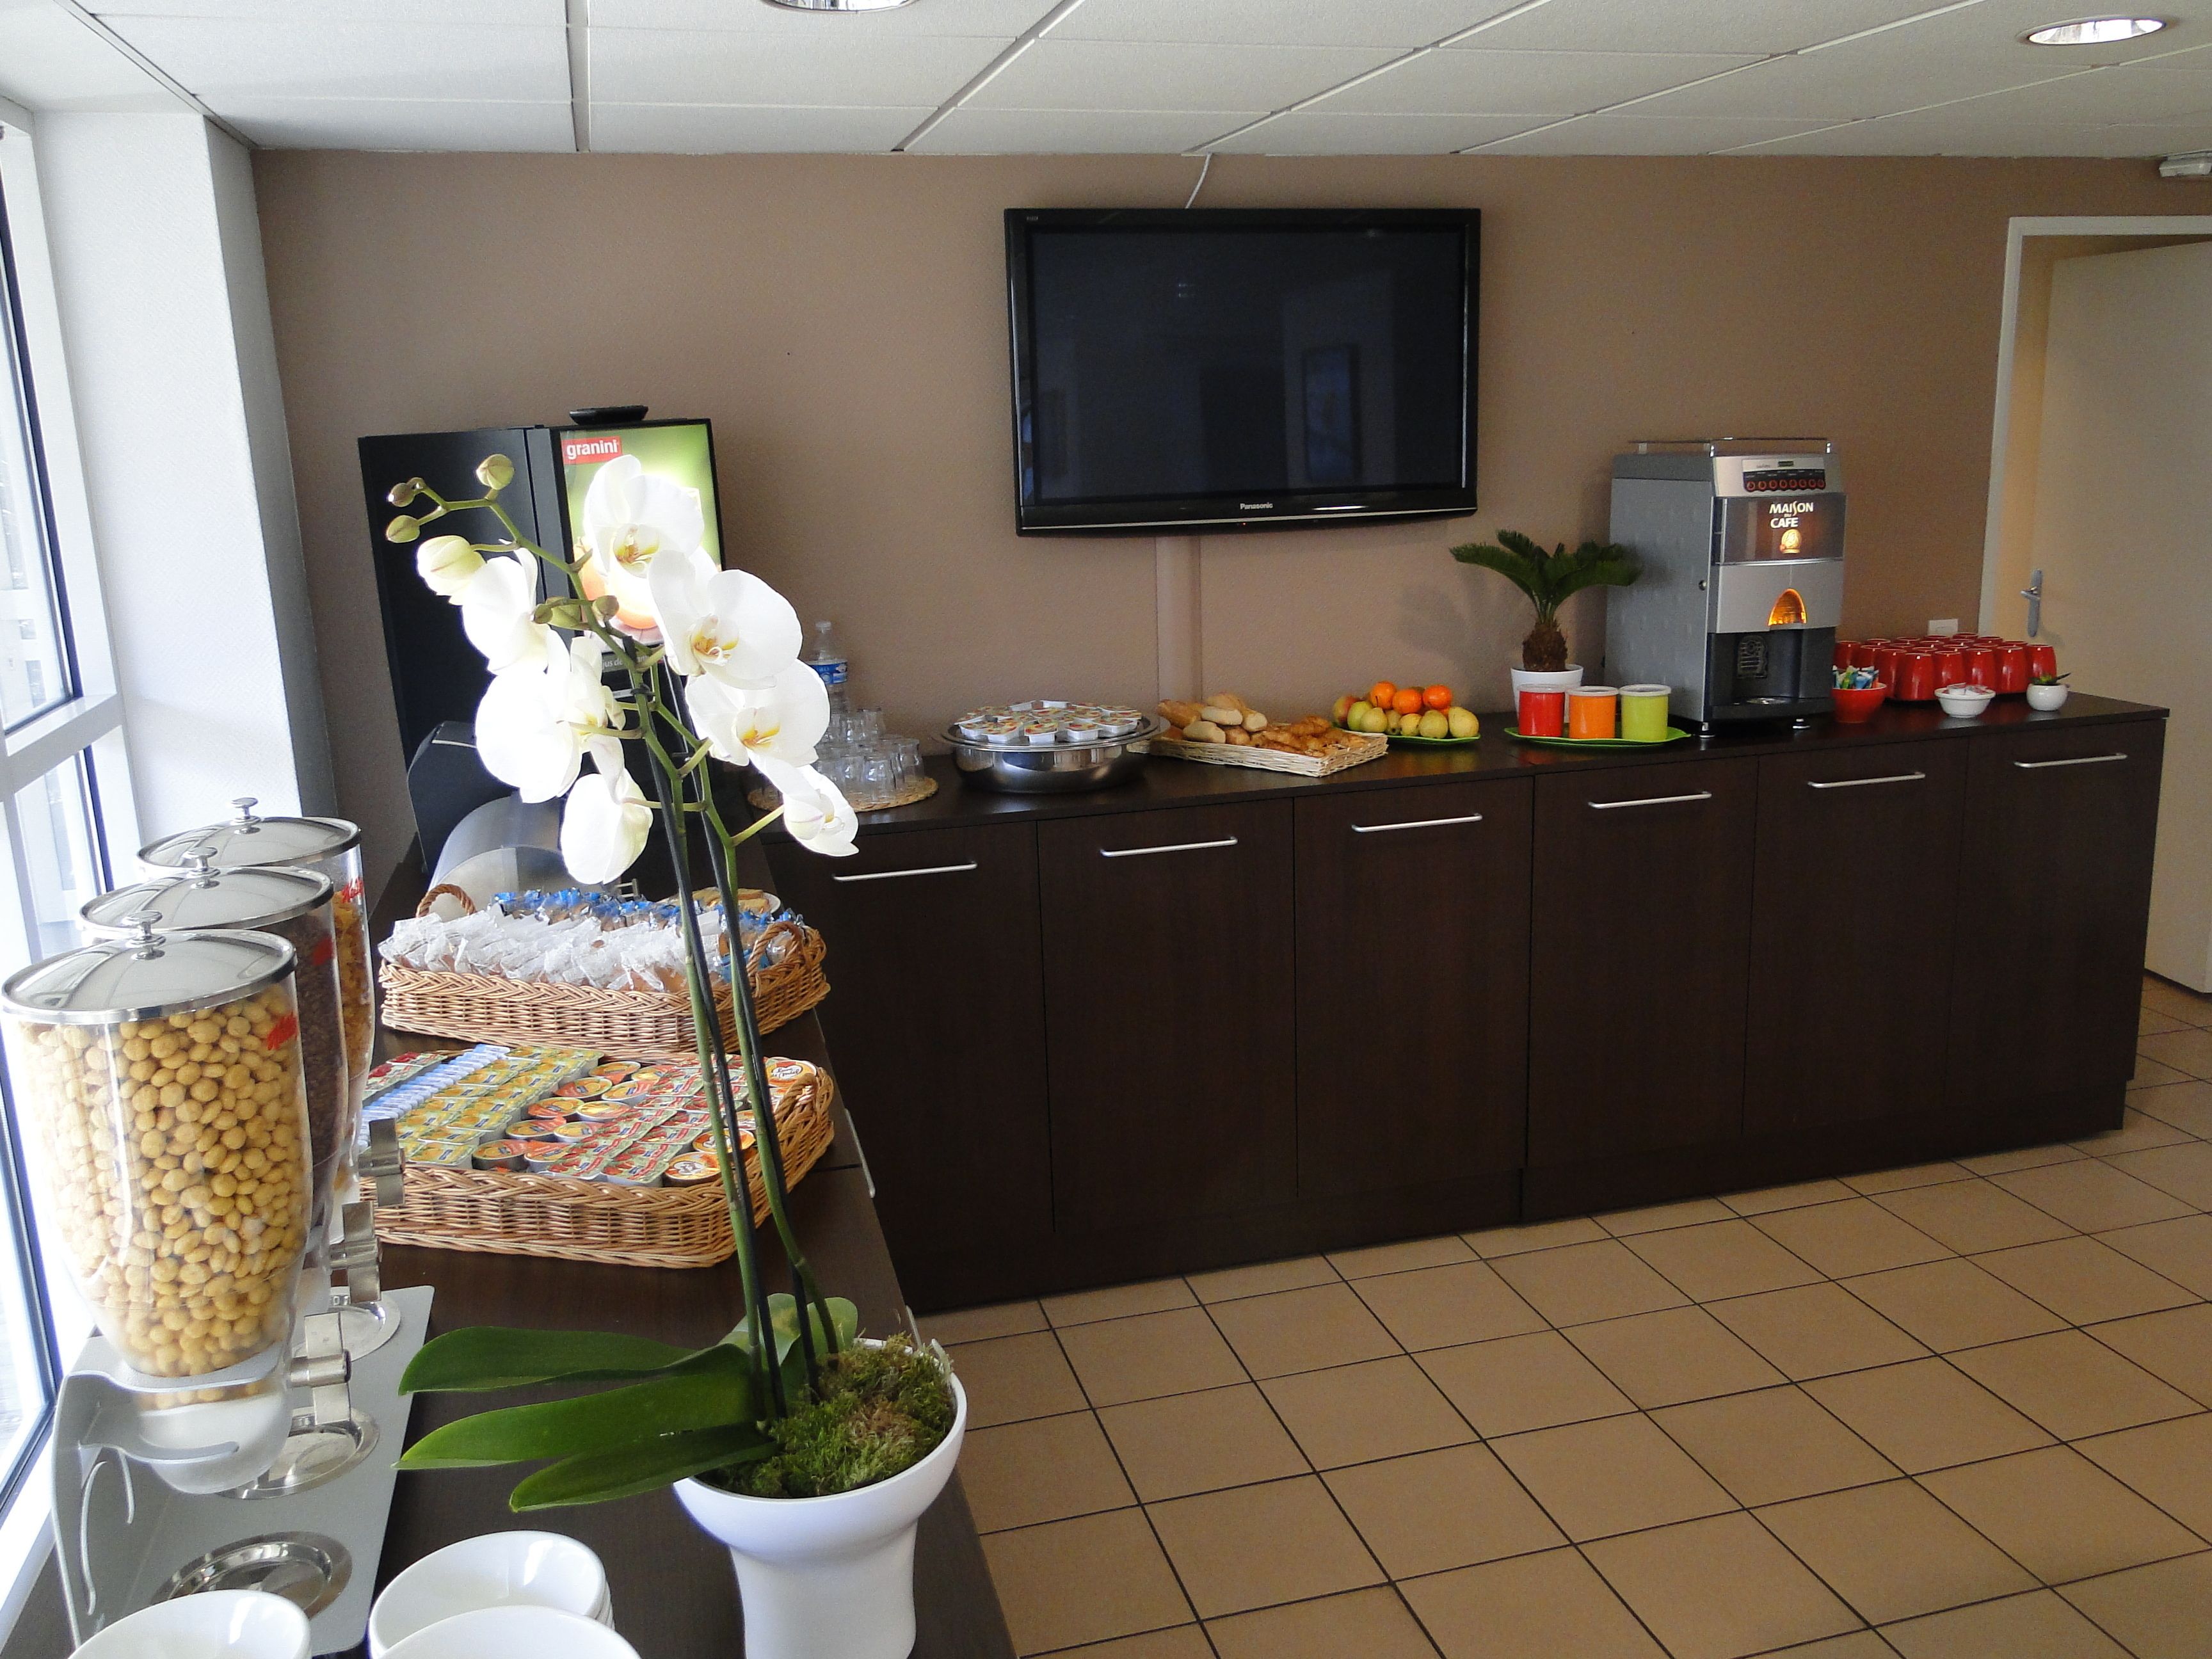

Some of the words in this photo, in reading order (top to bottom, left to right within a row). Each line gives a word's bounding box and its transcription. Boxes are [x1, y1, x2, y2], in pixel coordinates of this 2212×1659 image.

[566, 439, 618, 460] granini
[1768, 501, 1814, 517] MAISON
[602, 659, 613, 669] jus
